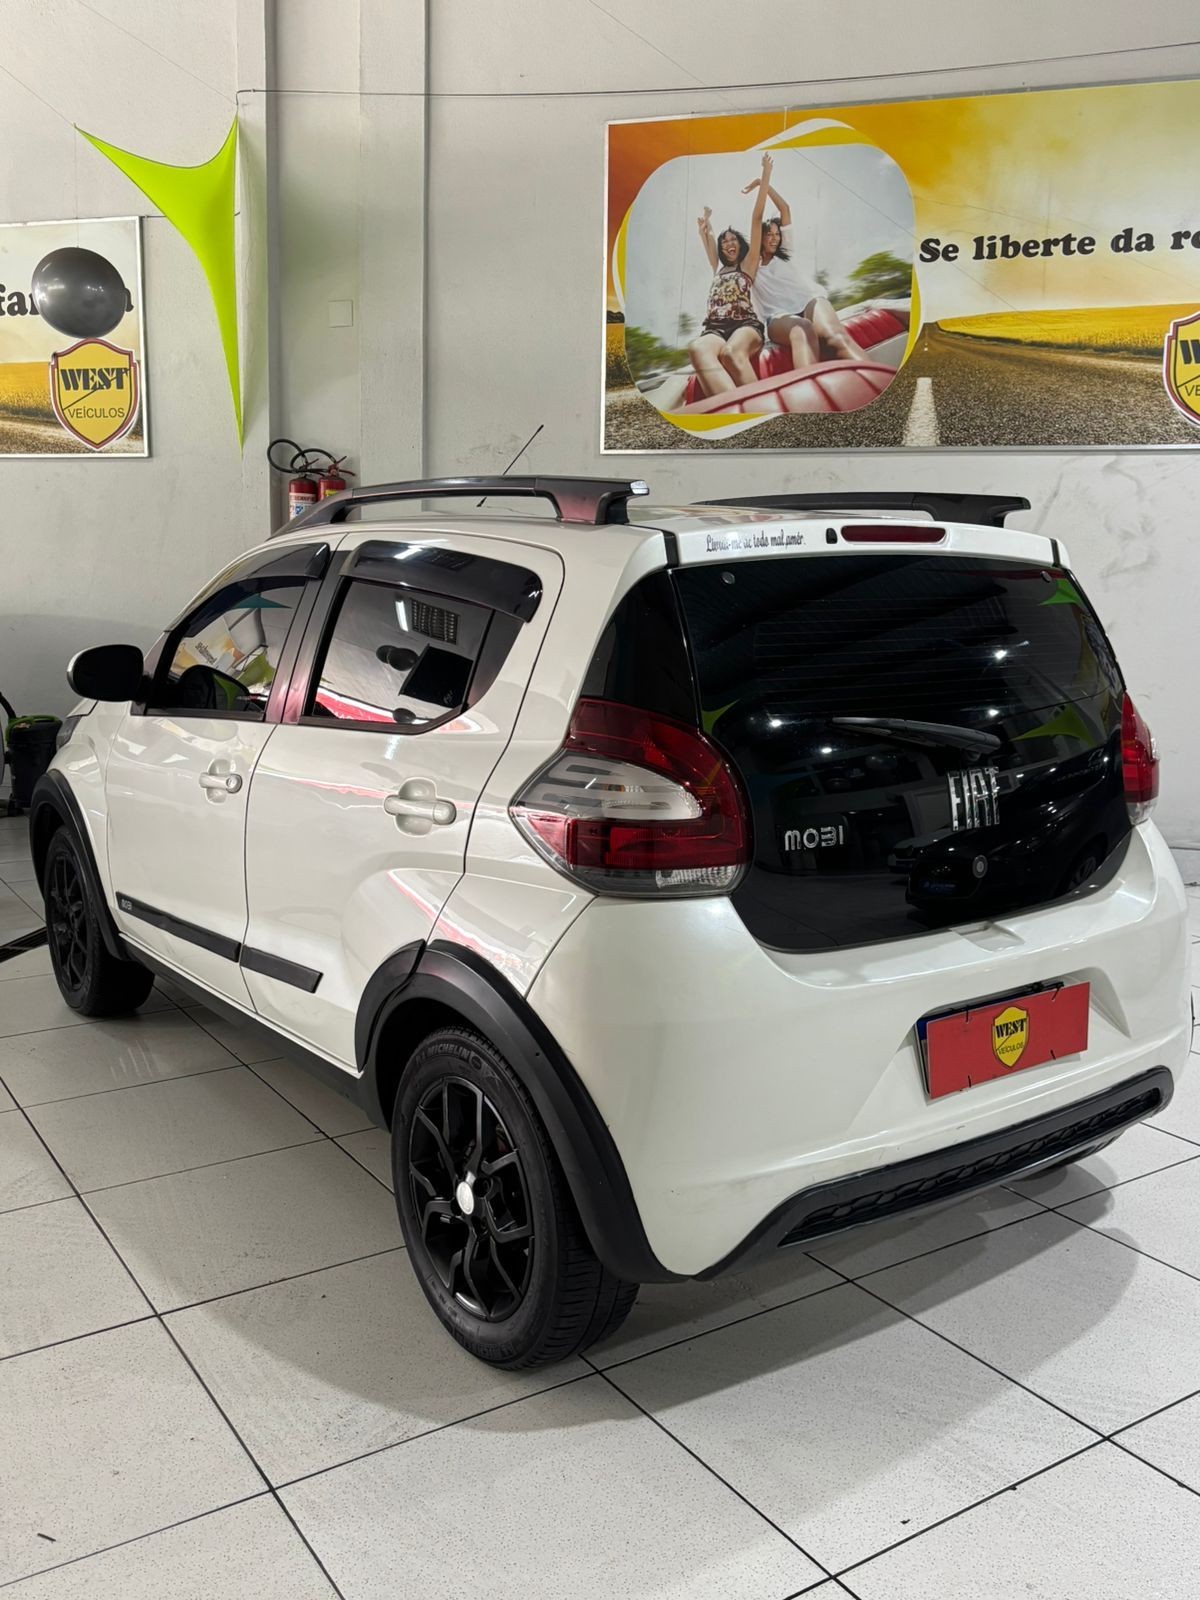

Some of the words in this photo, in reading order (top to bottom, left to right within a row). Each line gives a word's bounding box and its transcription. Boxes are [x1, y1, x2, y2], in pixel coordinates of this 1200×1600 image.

[919, 237, 959, 263] Se
[972, 232, 1096, 260] liberte
[1110, 227, 1156, 253] da
[60, 367, 129, 391] WEST
[68, 405, 125, 418] VEÍCULOS
[947, 766, 1000, 831] FIAT
[995, 1018, 1027, 1038] WEST
[427, 1043, 470, 1060] MICHELIN
